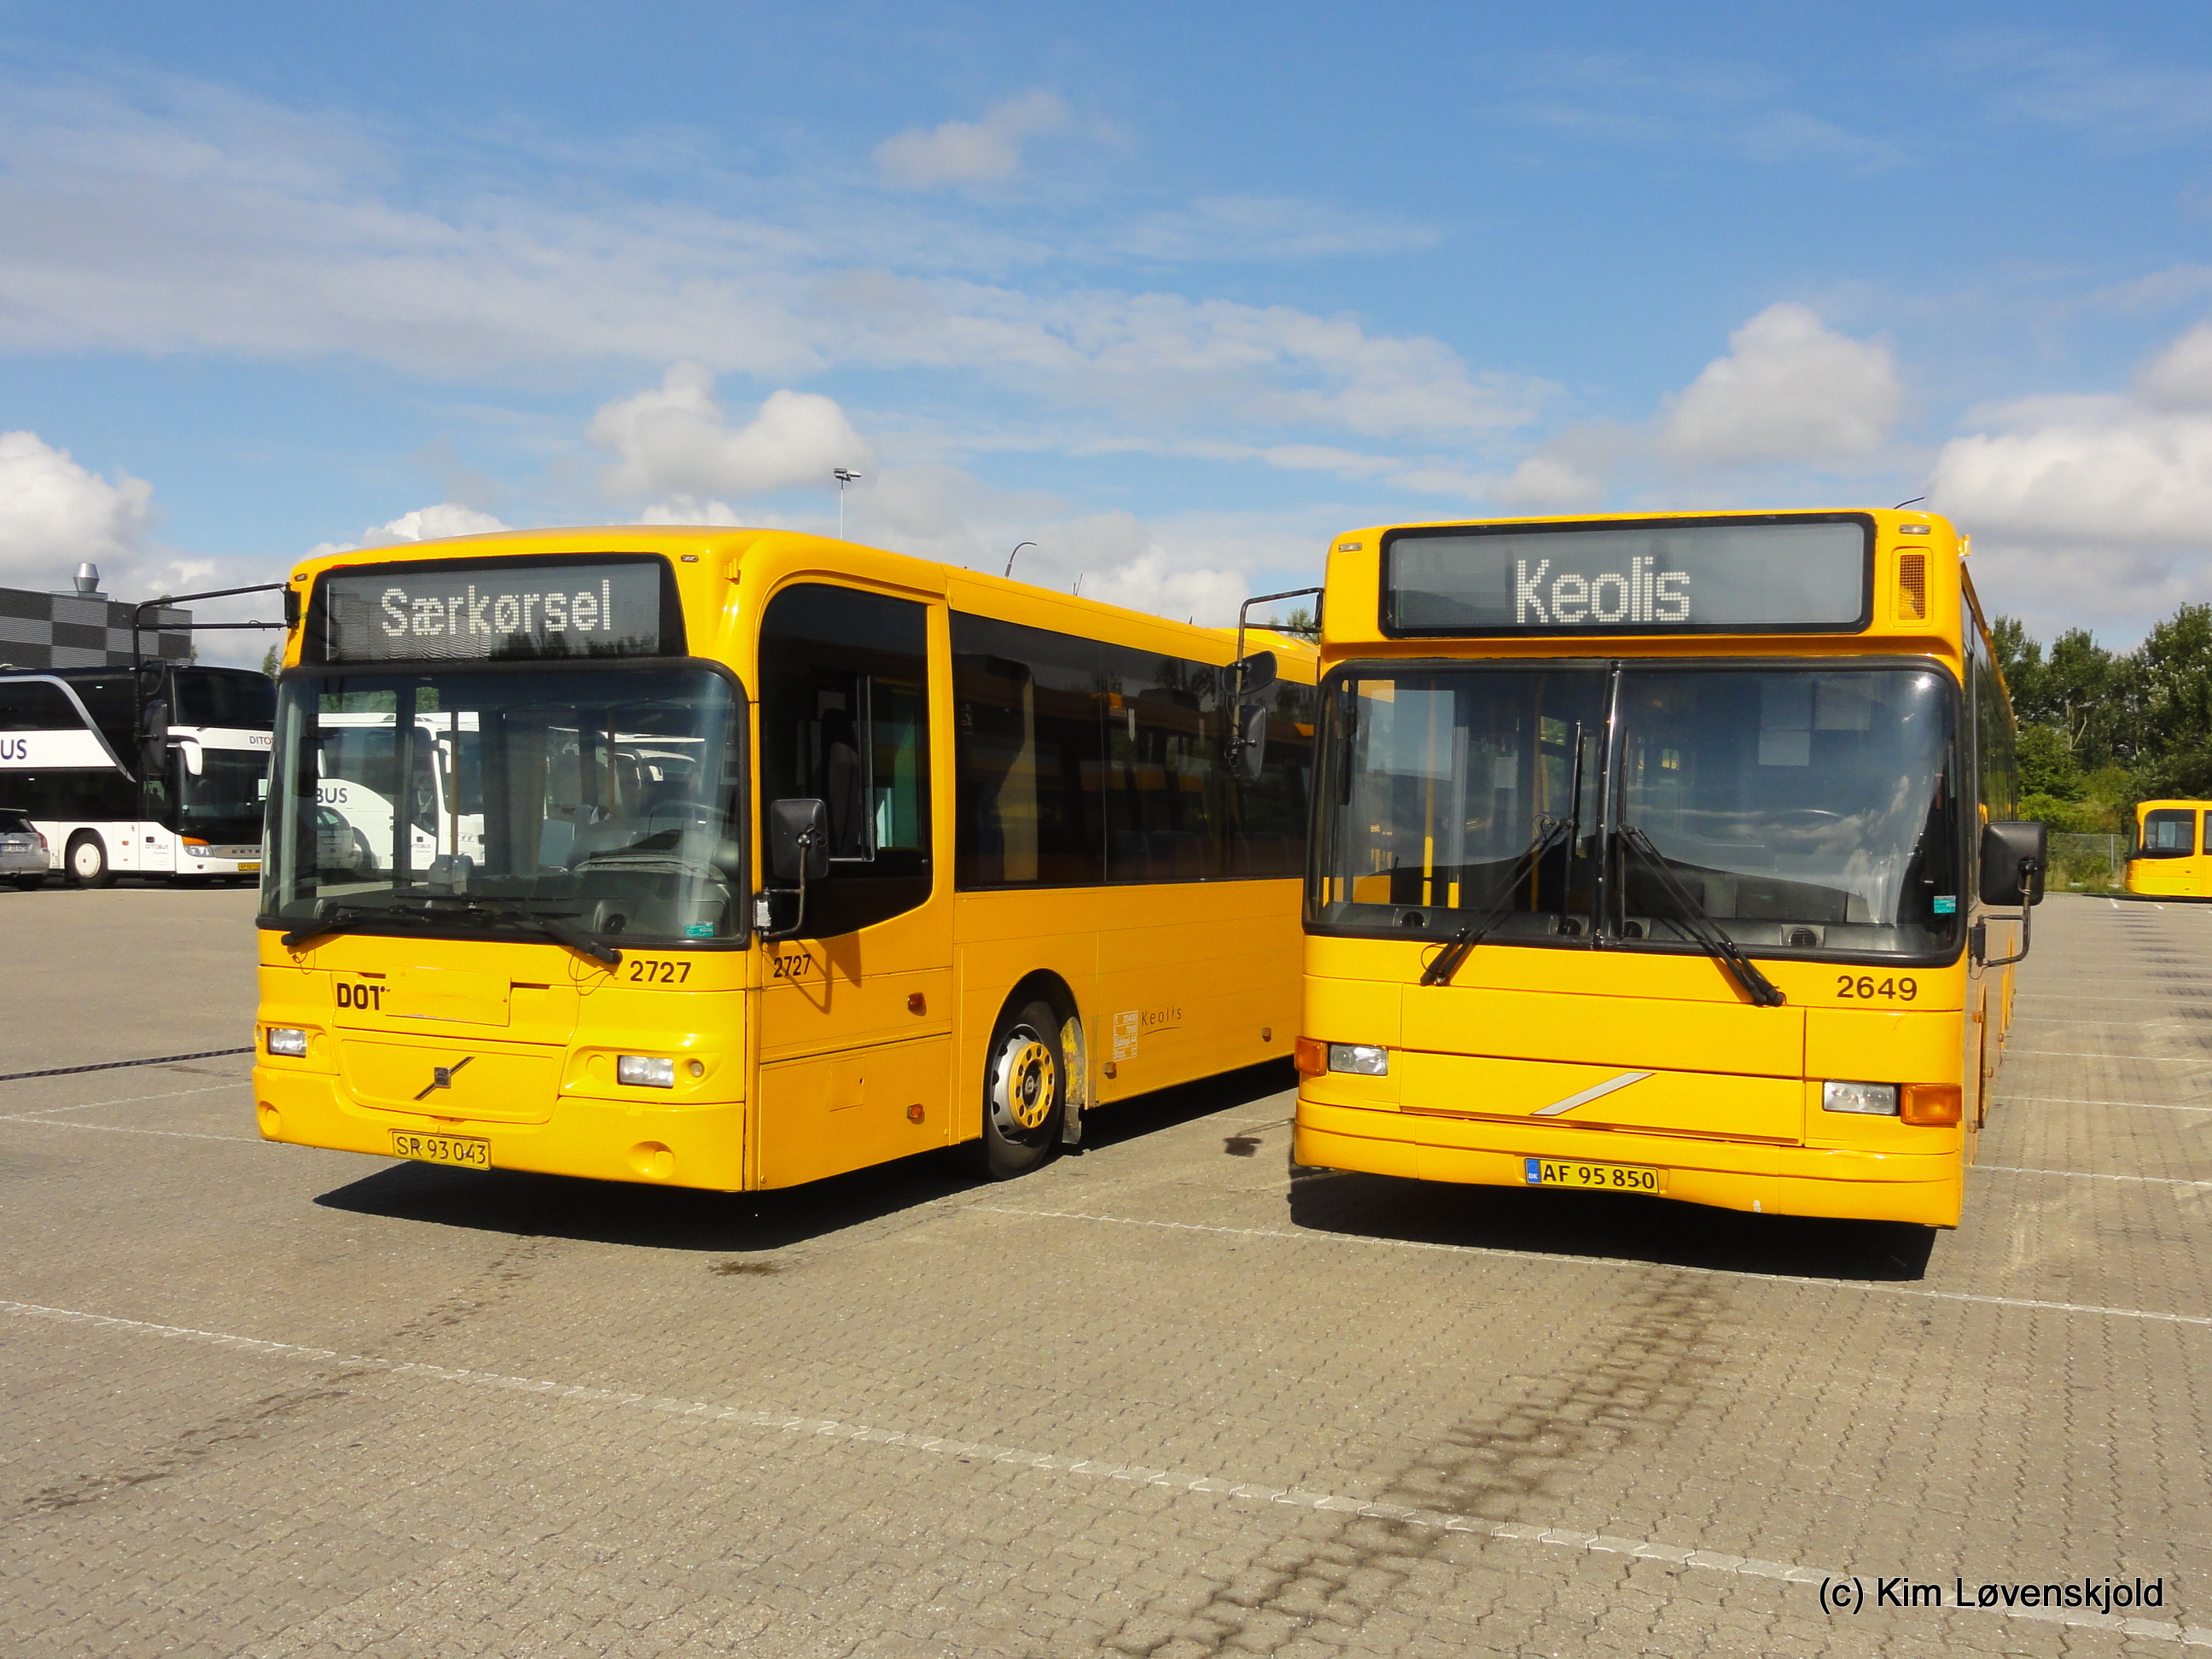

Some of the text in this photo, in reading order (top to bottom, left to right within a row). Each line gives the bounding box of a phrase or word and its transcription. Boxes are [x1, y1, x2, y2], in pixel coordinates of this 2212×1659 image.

[1516, 556, 1691, 624] Keolis
[381, 579, 611, 637] Særkørsel
[249, 736, 274, 745] DITO
[629, 960, 692, 983] 2727
[773, 953, 812, 978] 2727
[1837, 975, 1918, 1002] 2649
[1141, 1005, 1182, 1027] Keolis
[397, 1136, 486, 1164] SR 93 043
[1543, 1164, 1655, 1189] AF 95 850
